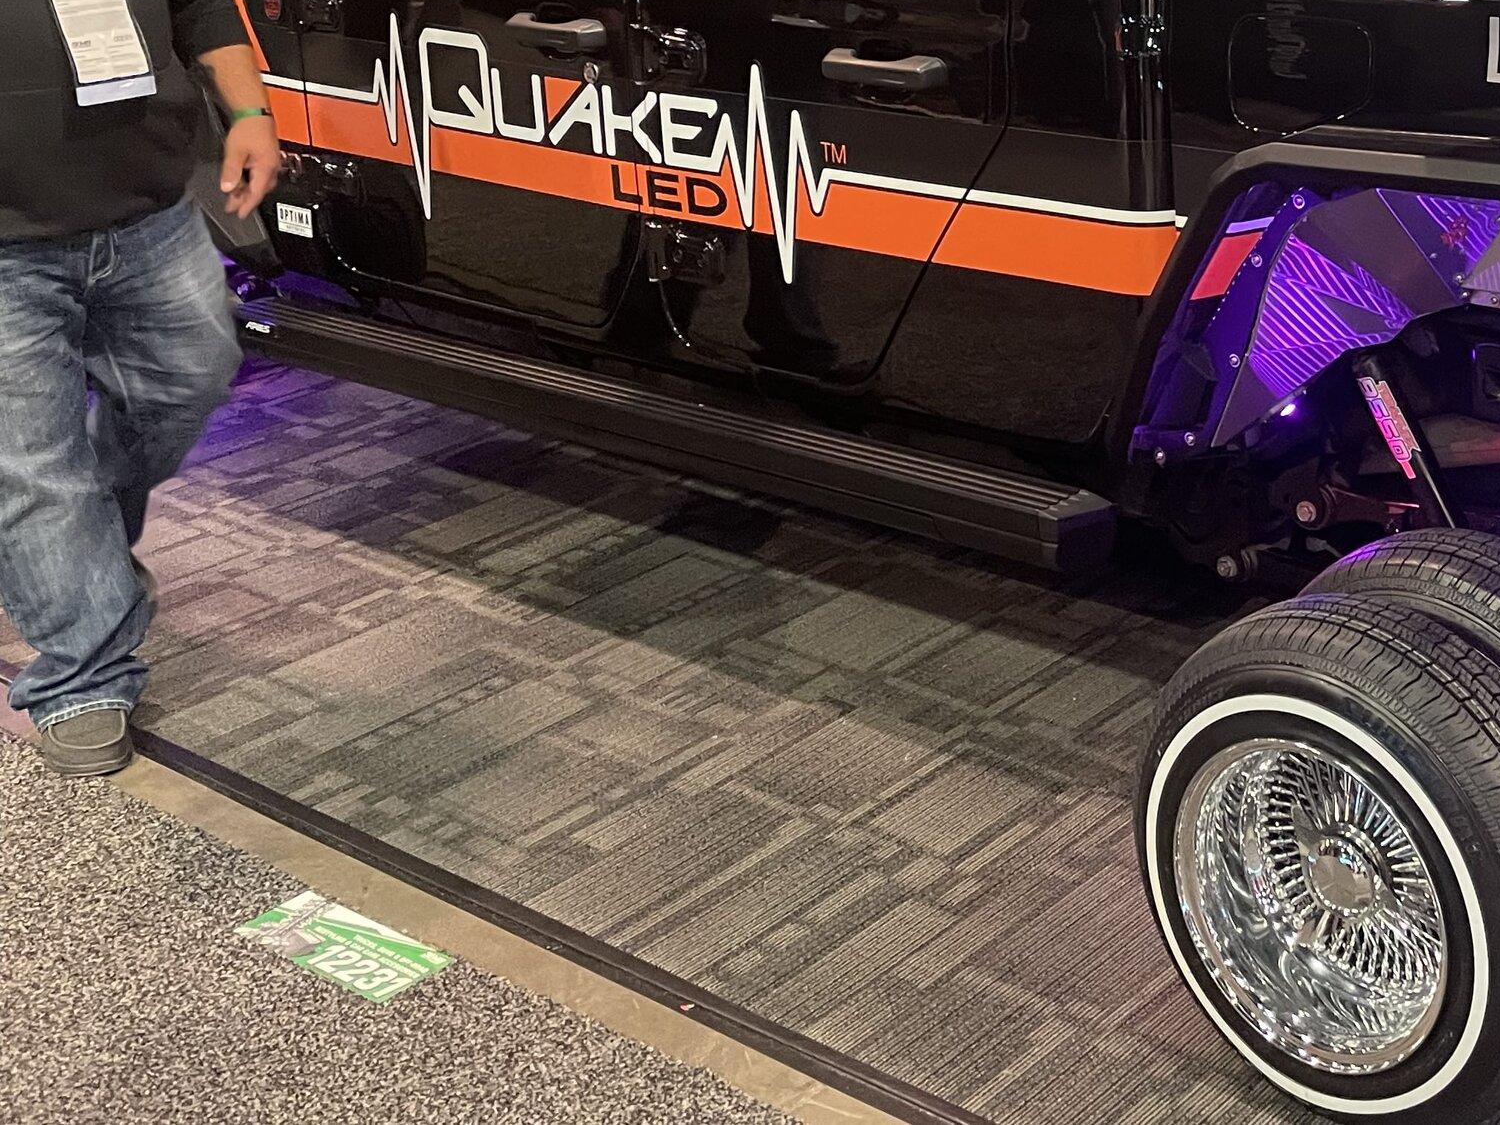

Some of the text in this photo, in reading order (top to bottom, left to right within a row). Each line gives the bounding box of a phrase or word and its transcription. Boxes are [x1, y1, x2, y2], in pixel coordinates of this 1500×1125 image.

[280, 208, 310, 226] OPTIMA
[610, 163, 728, 217] LED
[306, 944, 414, 998] 12231
